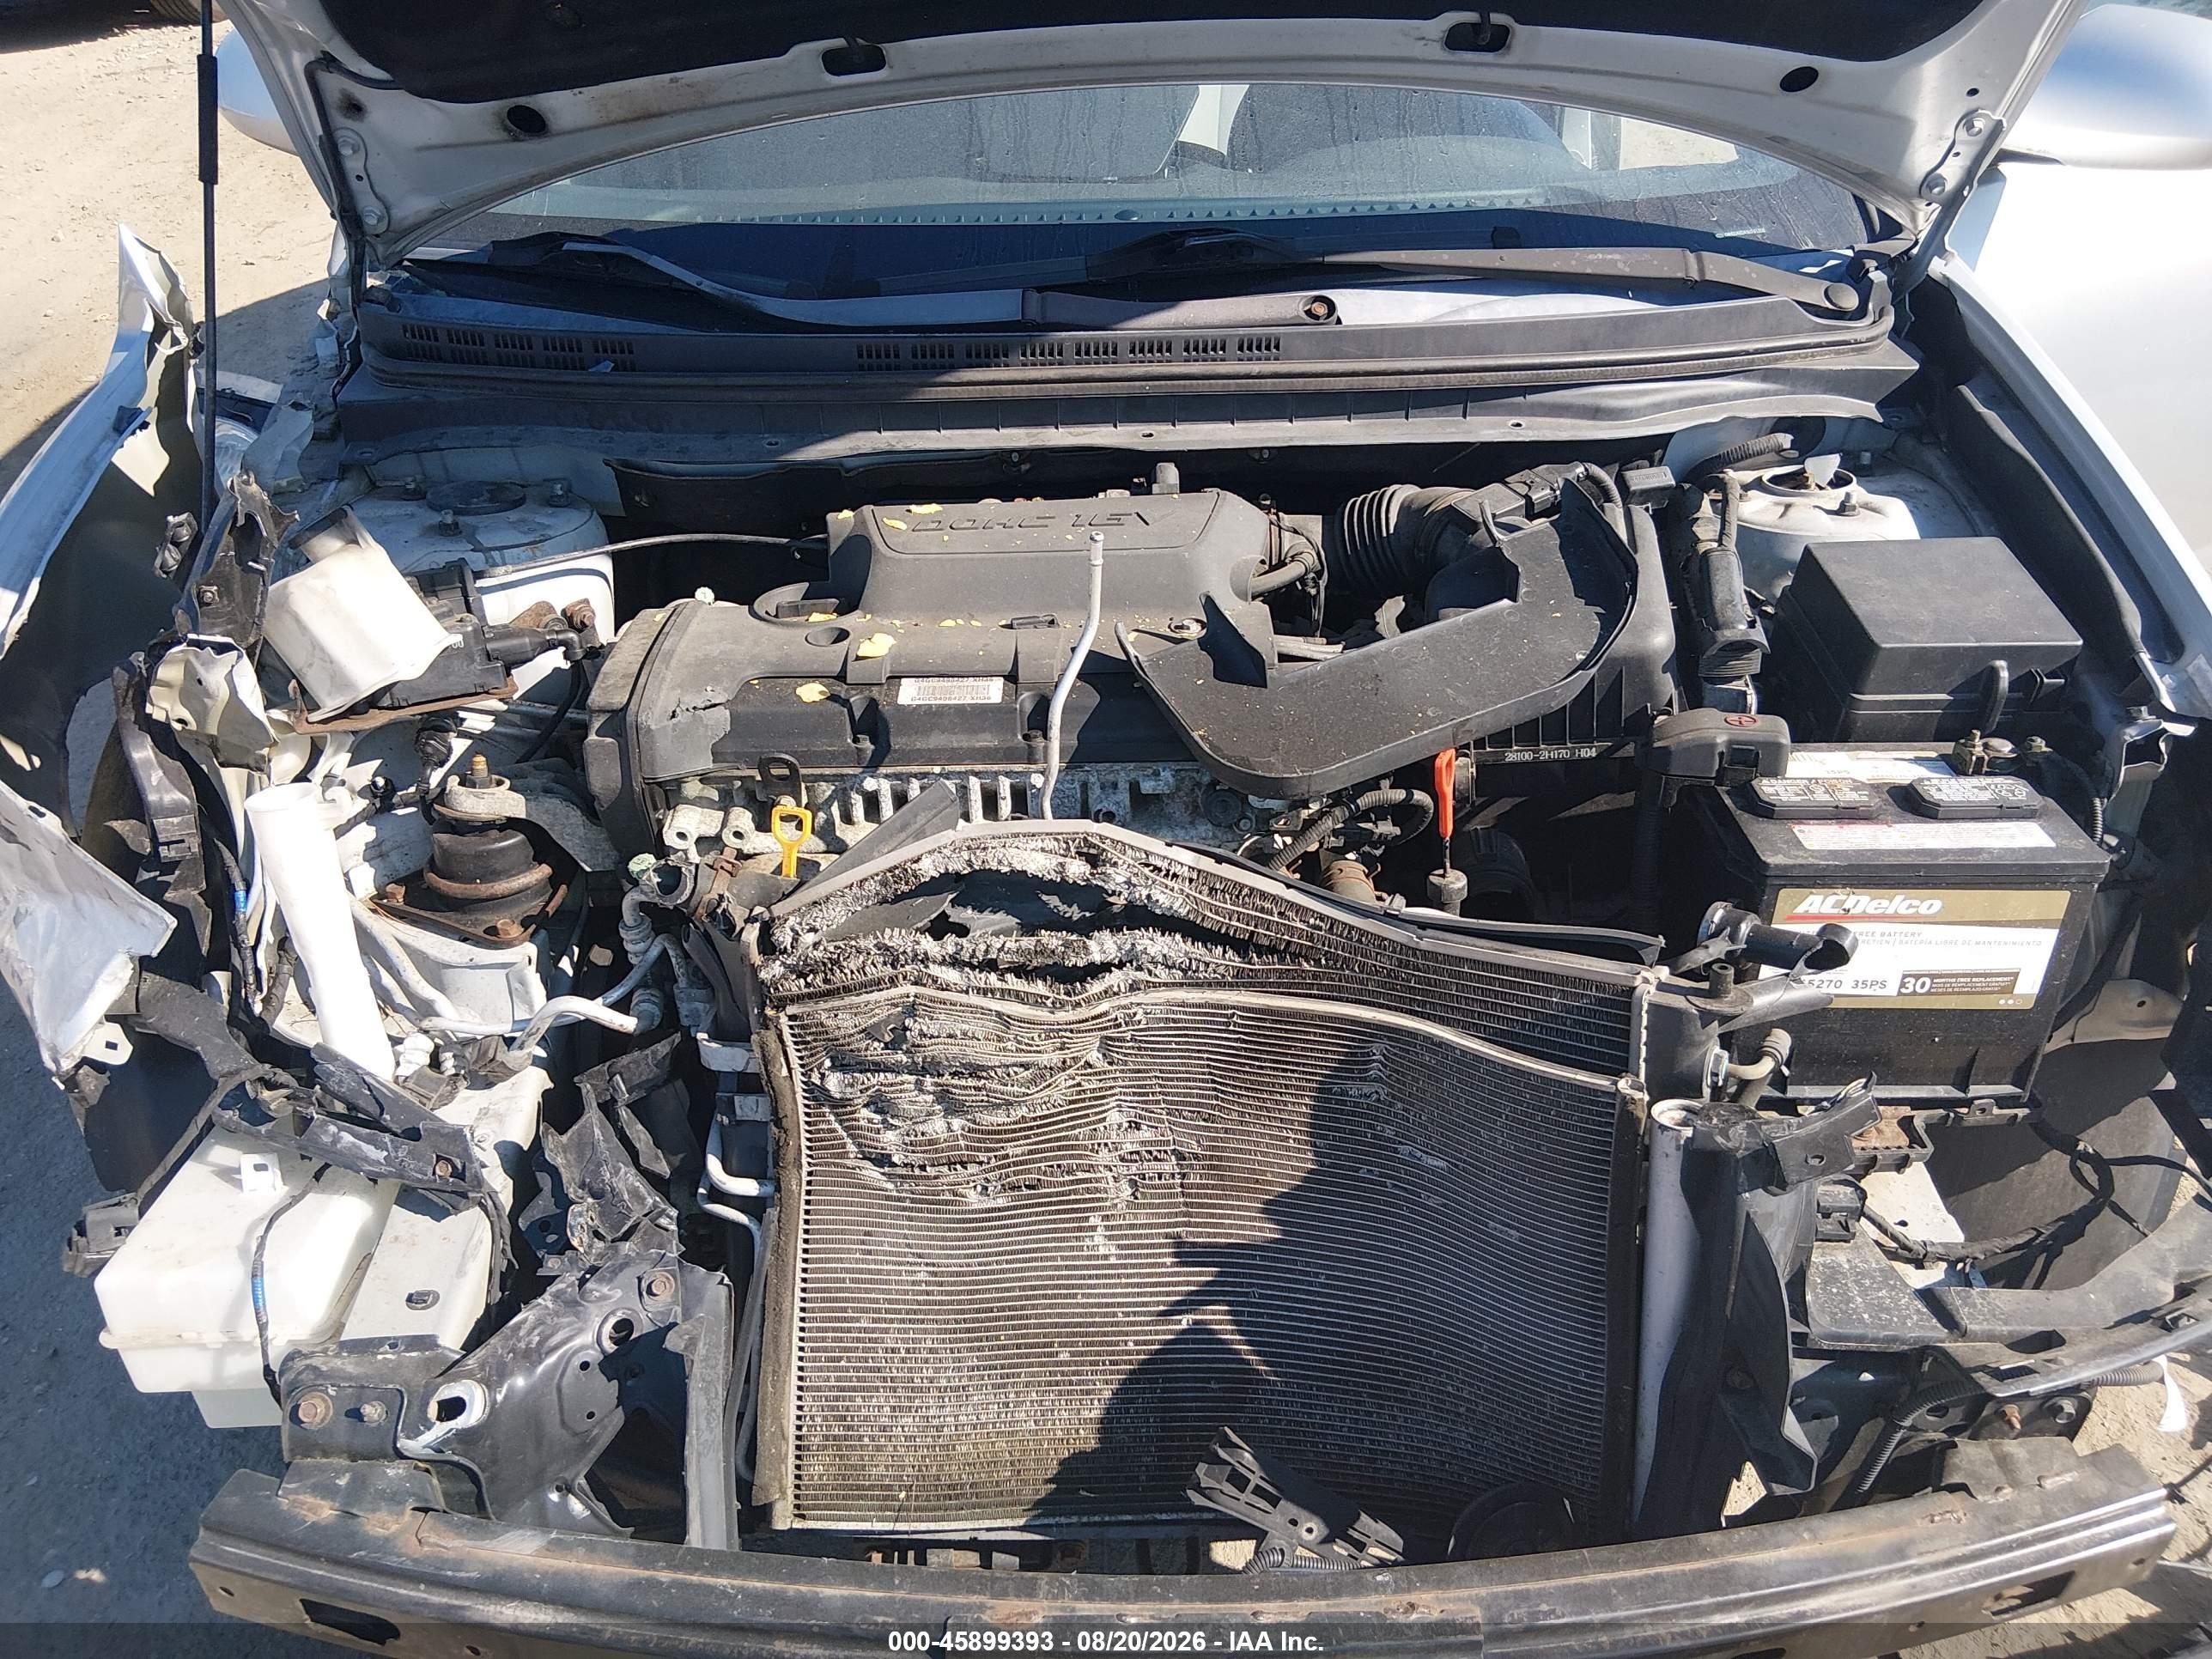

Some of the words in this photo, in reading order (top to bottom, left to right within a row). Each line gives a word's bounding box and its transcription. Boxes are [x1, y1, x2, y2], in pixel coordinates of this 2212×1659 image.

[911, 514, 1057, 532] DOHC
[1504, 749, 1571, 762] 28100-2H170
[1575, 748, 1597, 757] H04
[1792, 894, 1943, 915] ACDelco
[1851, 979, 1887, 989] 35PS
[1899, 976, 1931, 994] 30
